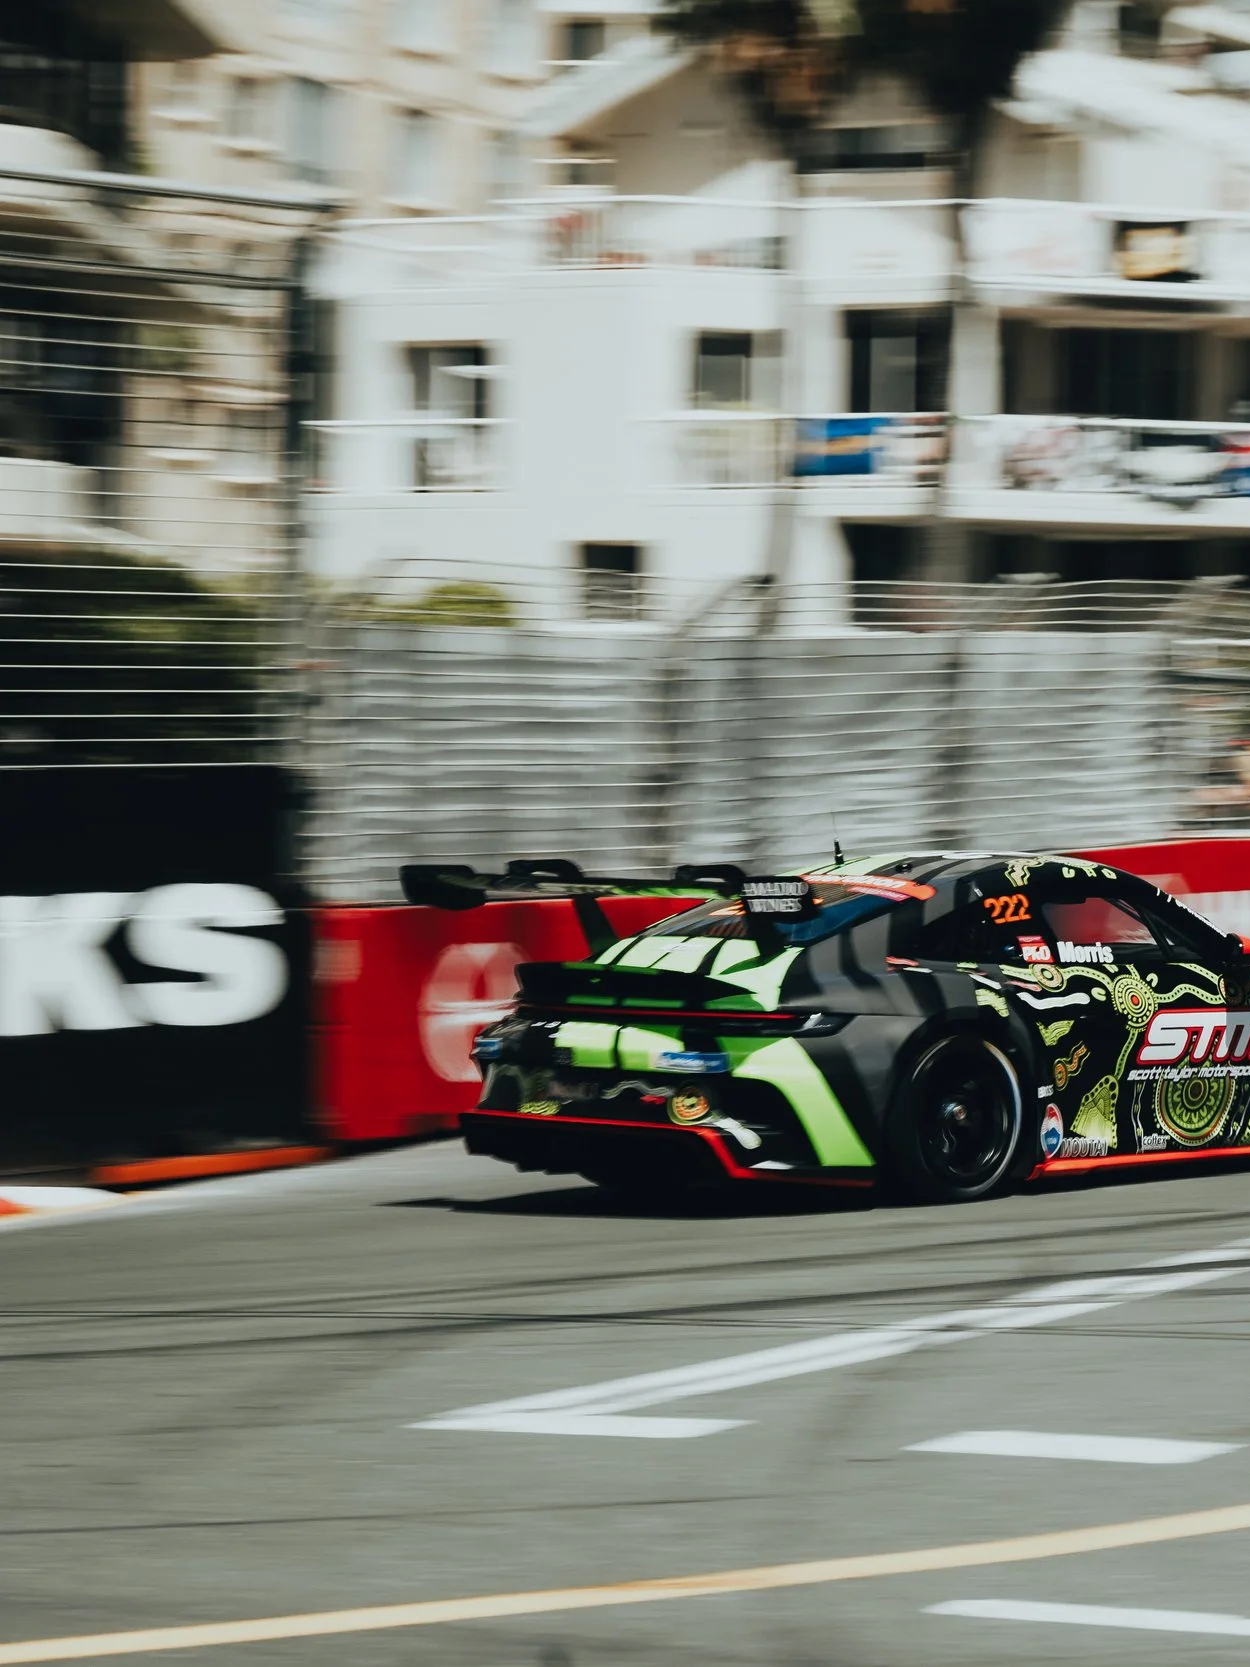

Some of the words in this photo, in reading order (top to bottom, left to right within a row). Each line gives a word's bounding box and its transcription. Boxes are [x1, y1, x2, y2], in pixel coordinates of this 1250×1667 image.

[983, 893, 1032, 924] 222
[1056, 941, 1114, 963] Morris
[1127, 1066, 1162, 1081] scott
[1163, 1065, 1198, 1082] taylor
[1060, 1136, 1109, 1158] MOUTAI
